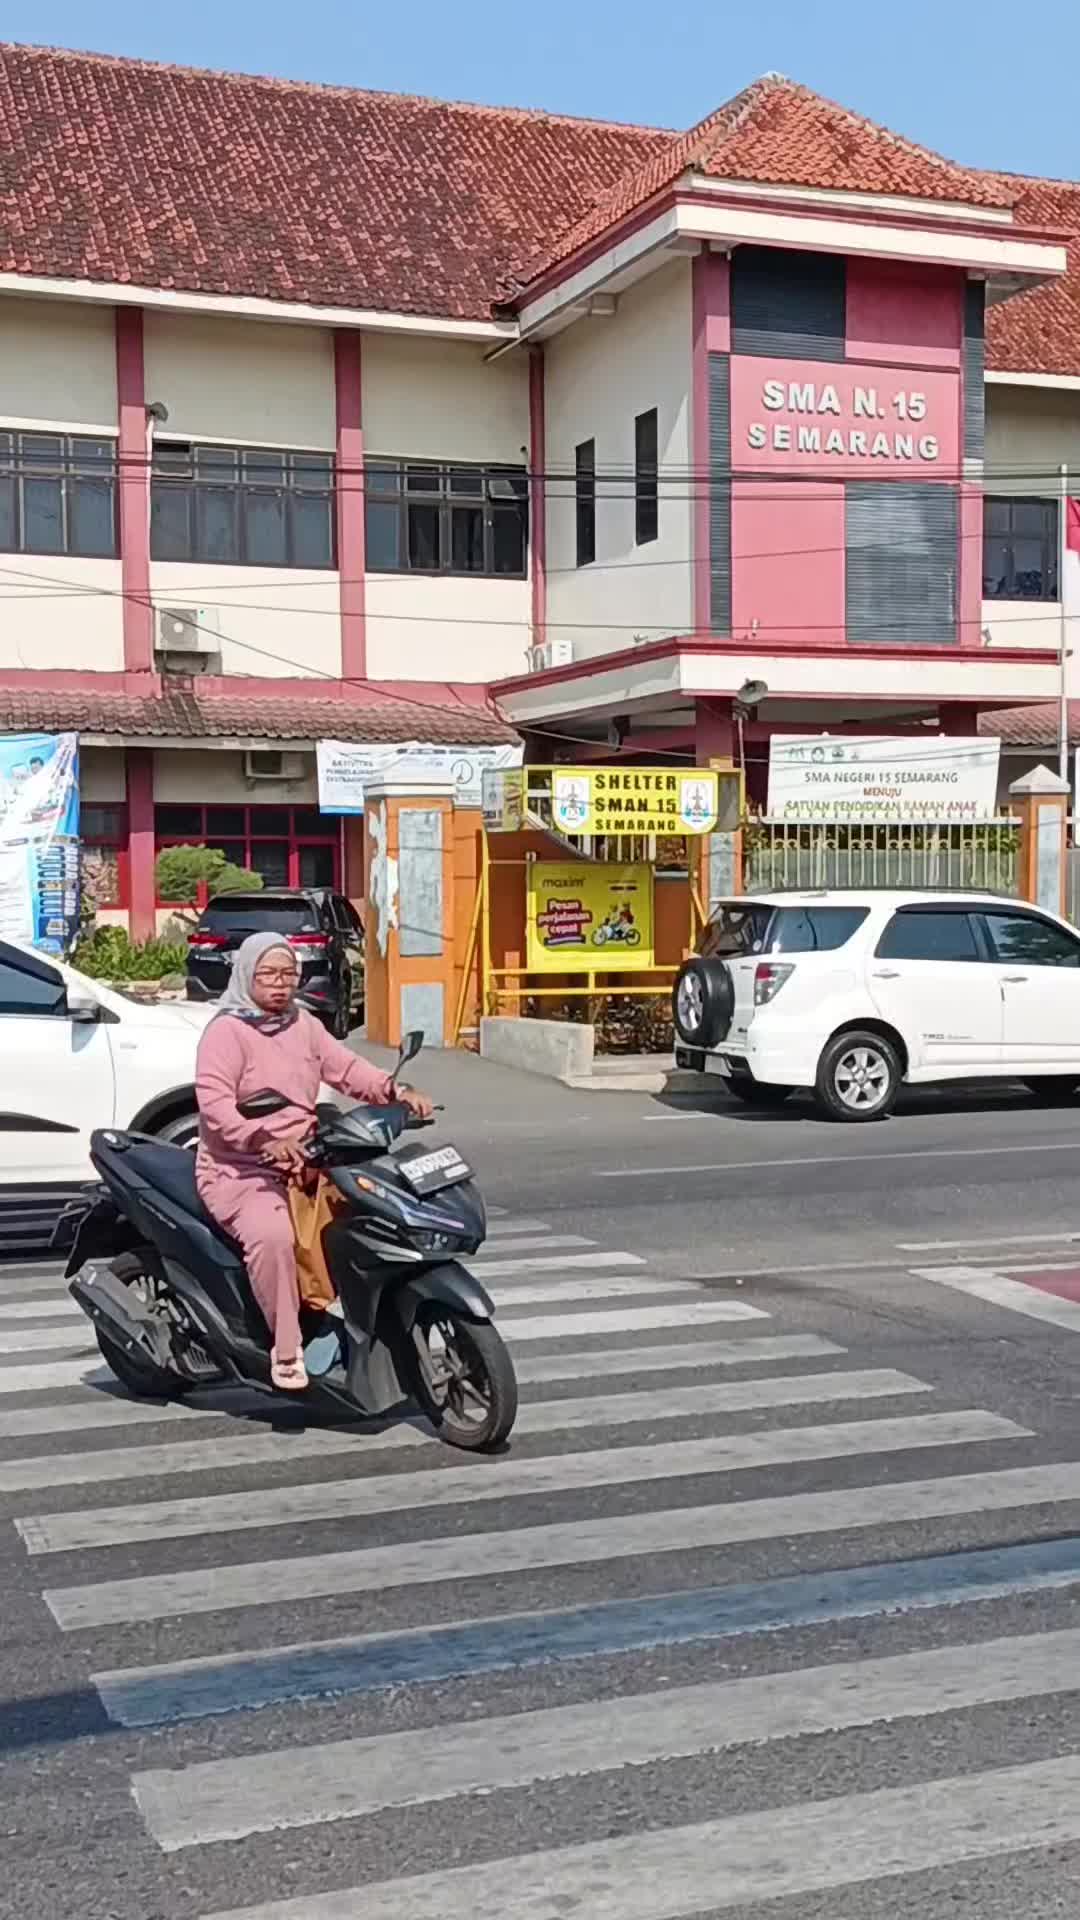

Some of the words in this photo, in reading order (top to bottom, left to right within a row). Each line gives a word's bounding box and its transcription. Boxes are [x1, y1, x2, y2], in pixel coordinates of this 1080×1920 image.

[763, 380, 841, 416] SMA
[853, 387, 886, 419] N.
[892, 391, 927, 422] 15
[747, 423, 939, 461] SEMARANG
[594, 773, 677, 790] SHELTER
[804, 772, 831, 783] SMA
[833, 772, 875, 783] NEGERI
[878, 772, 891, 783] 15
[894, 772, 959, 783] SEMARANG
[863, 787, 902, 798] MENUJU
[594, 798, 649, 813] SMAN
[657, 798, 677, 813] 15
[786, 800, 830, 811] SATUAN
[833, 801, 900, 811] PENDIDIKAN
[946, 801, 977, 812] ANAK
[594, 819, 676, 831] SEMARANG
[542, 875, 585, 888] maxim
